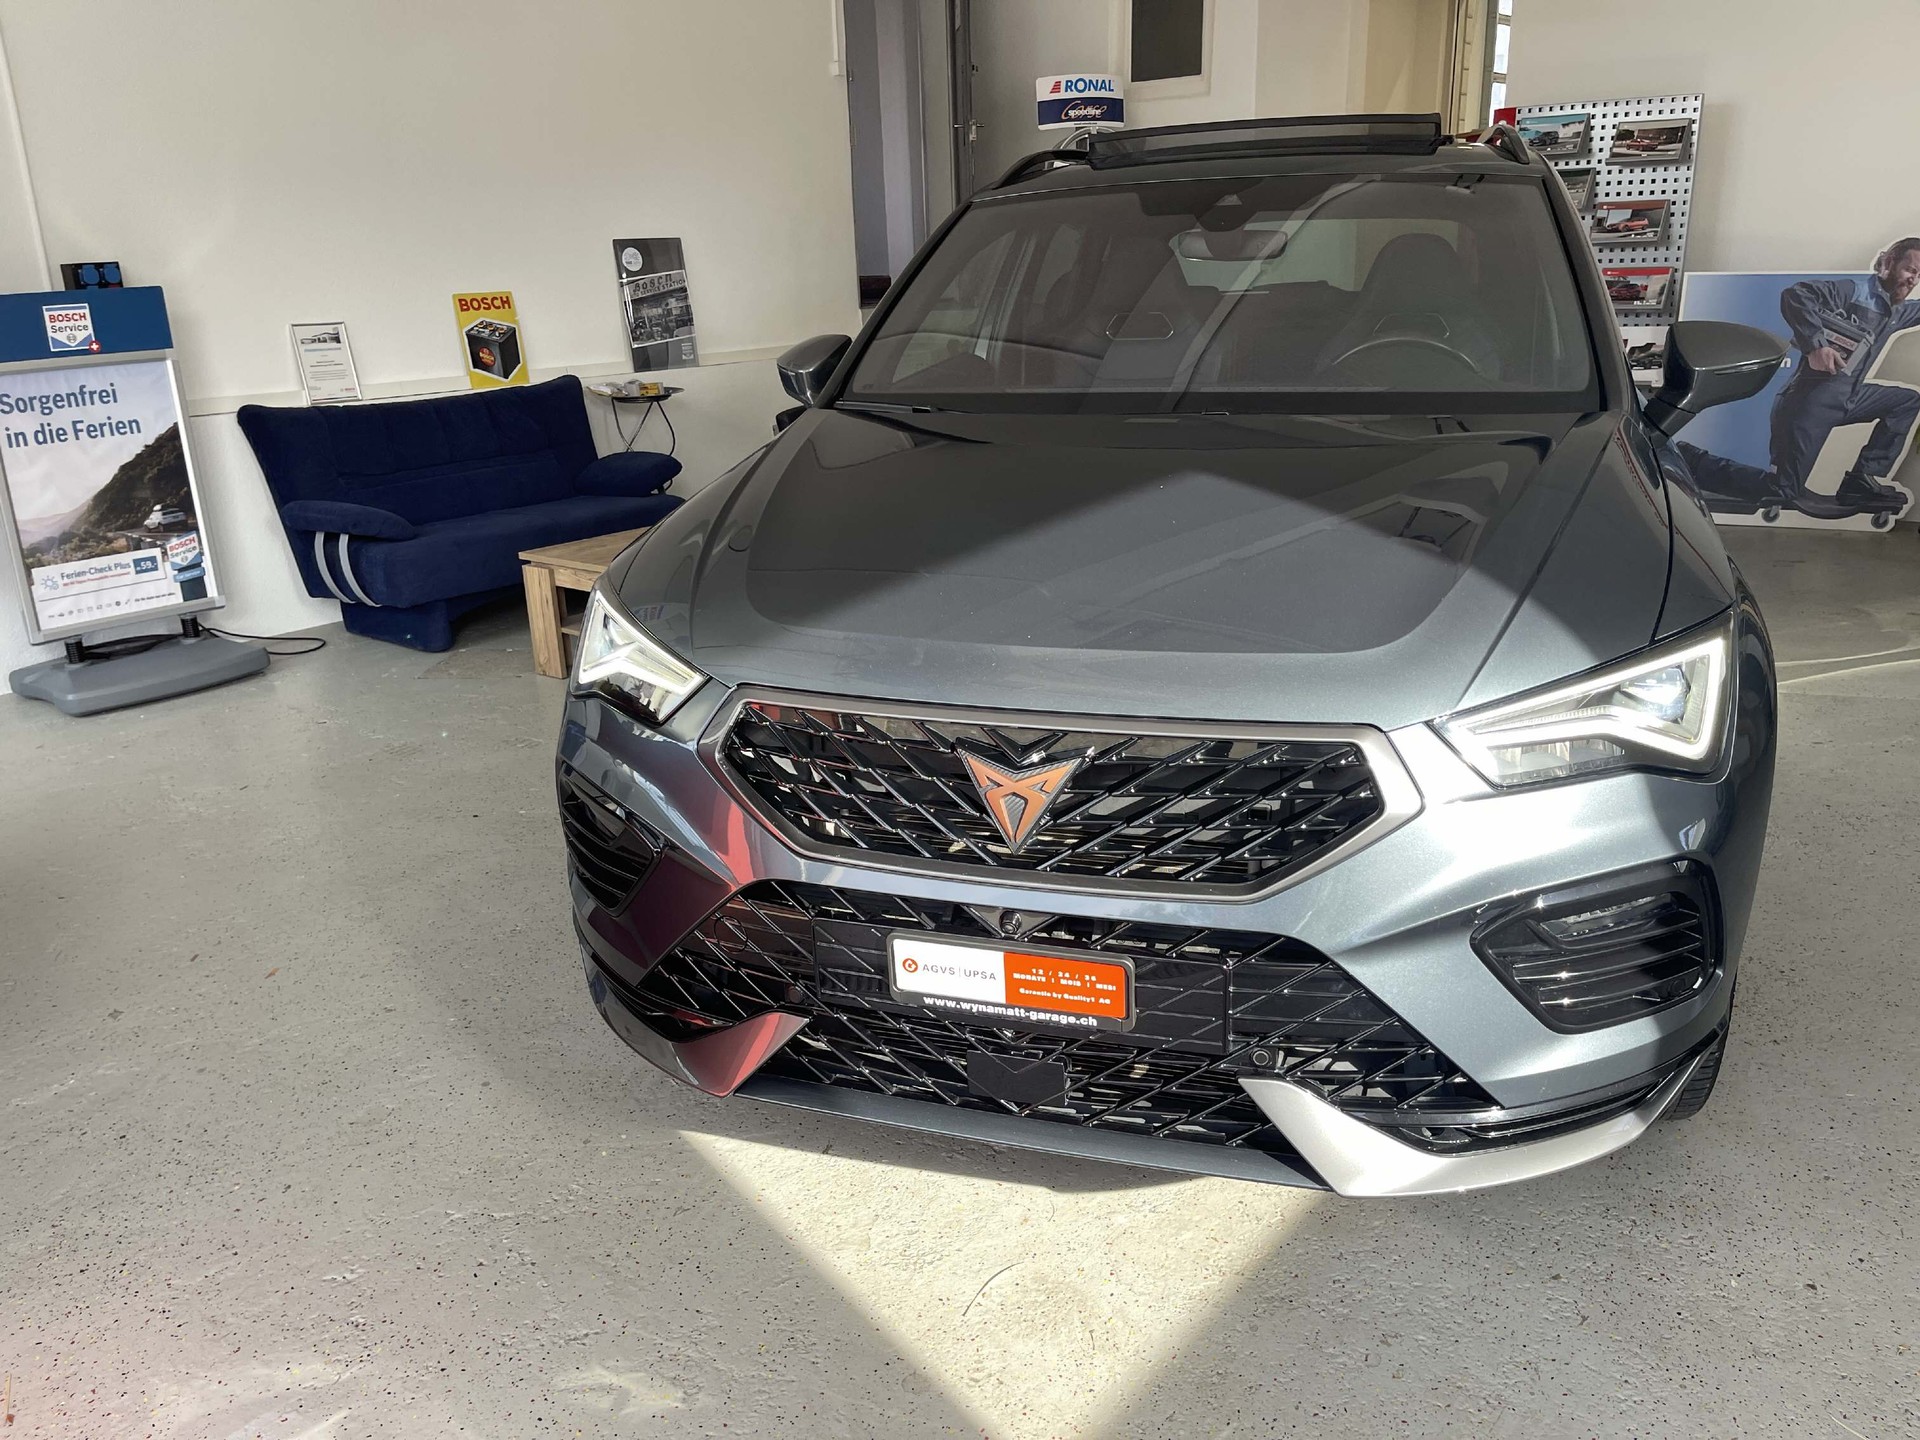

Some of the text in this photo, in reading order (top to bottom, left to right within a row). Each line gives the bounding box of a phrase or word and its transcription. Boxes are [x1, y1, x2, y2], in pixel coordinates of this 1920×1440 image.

[1064, 77, 1115, 94] RONAL
[457, 295, 512, 313] BOSCH
[48, 312, 87, 324] BOSCH
[50, 323, 89, 334] Service
[0, 382, 119, 416] Sorgenfrei
[5, 416, 142, 449] in die Ferien
[168, 536, 196, 552] BOSCH
[170, 545, 197, 558] Service
[60, 564, 113, 580] Ferien-Check
[114, 561, 132, 573] Plus
[922, 963, 997, 981] AGVS UPSA
[1052, 991, 1062, 999] by
[1098, 997, 1111, 1005] AG
[923, 996, 1098, 1027] www.wynamatt-garage.ch
